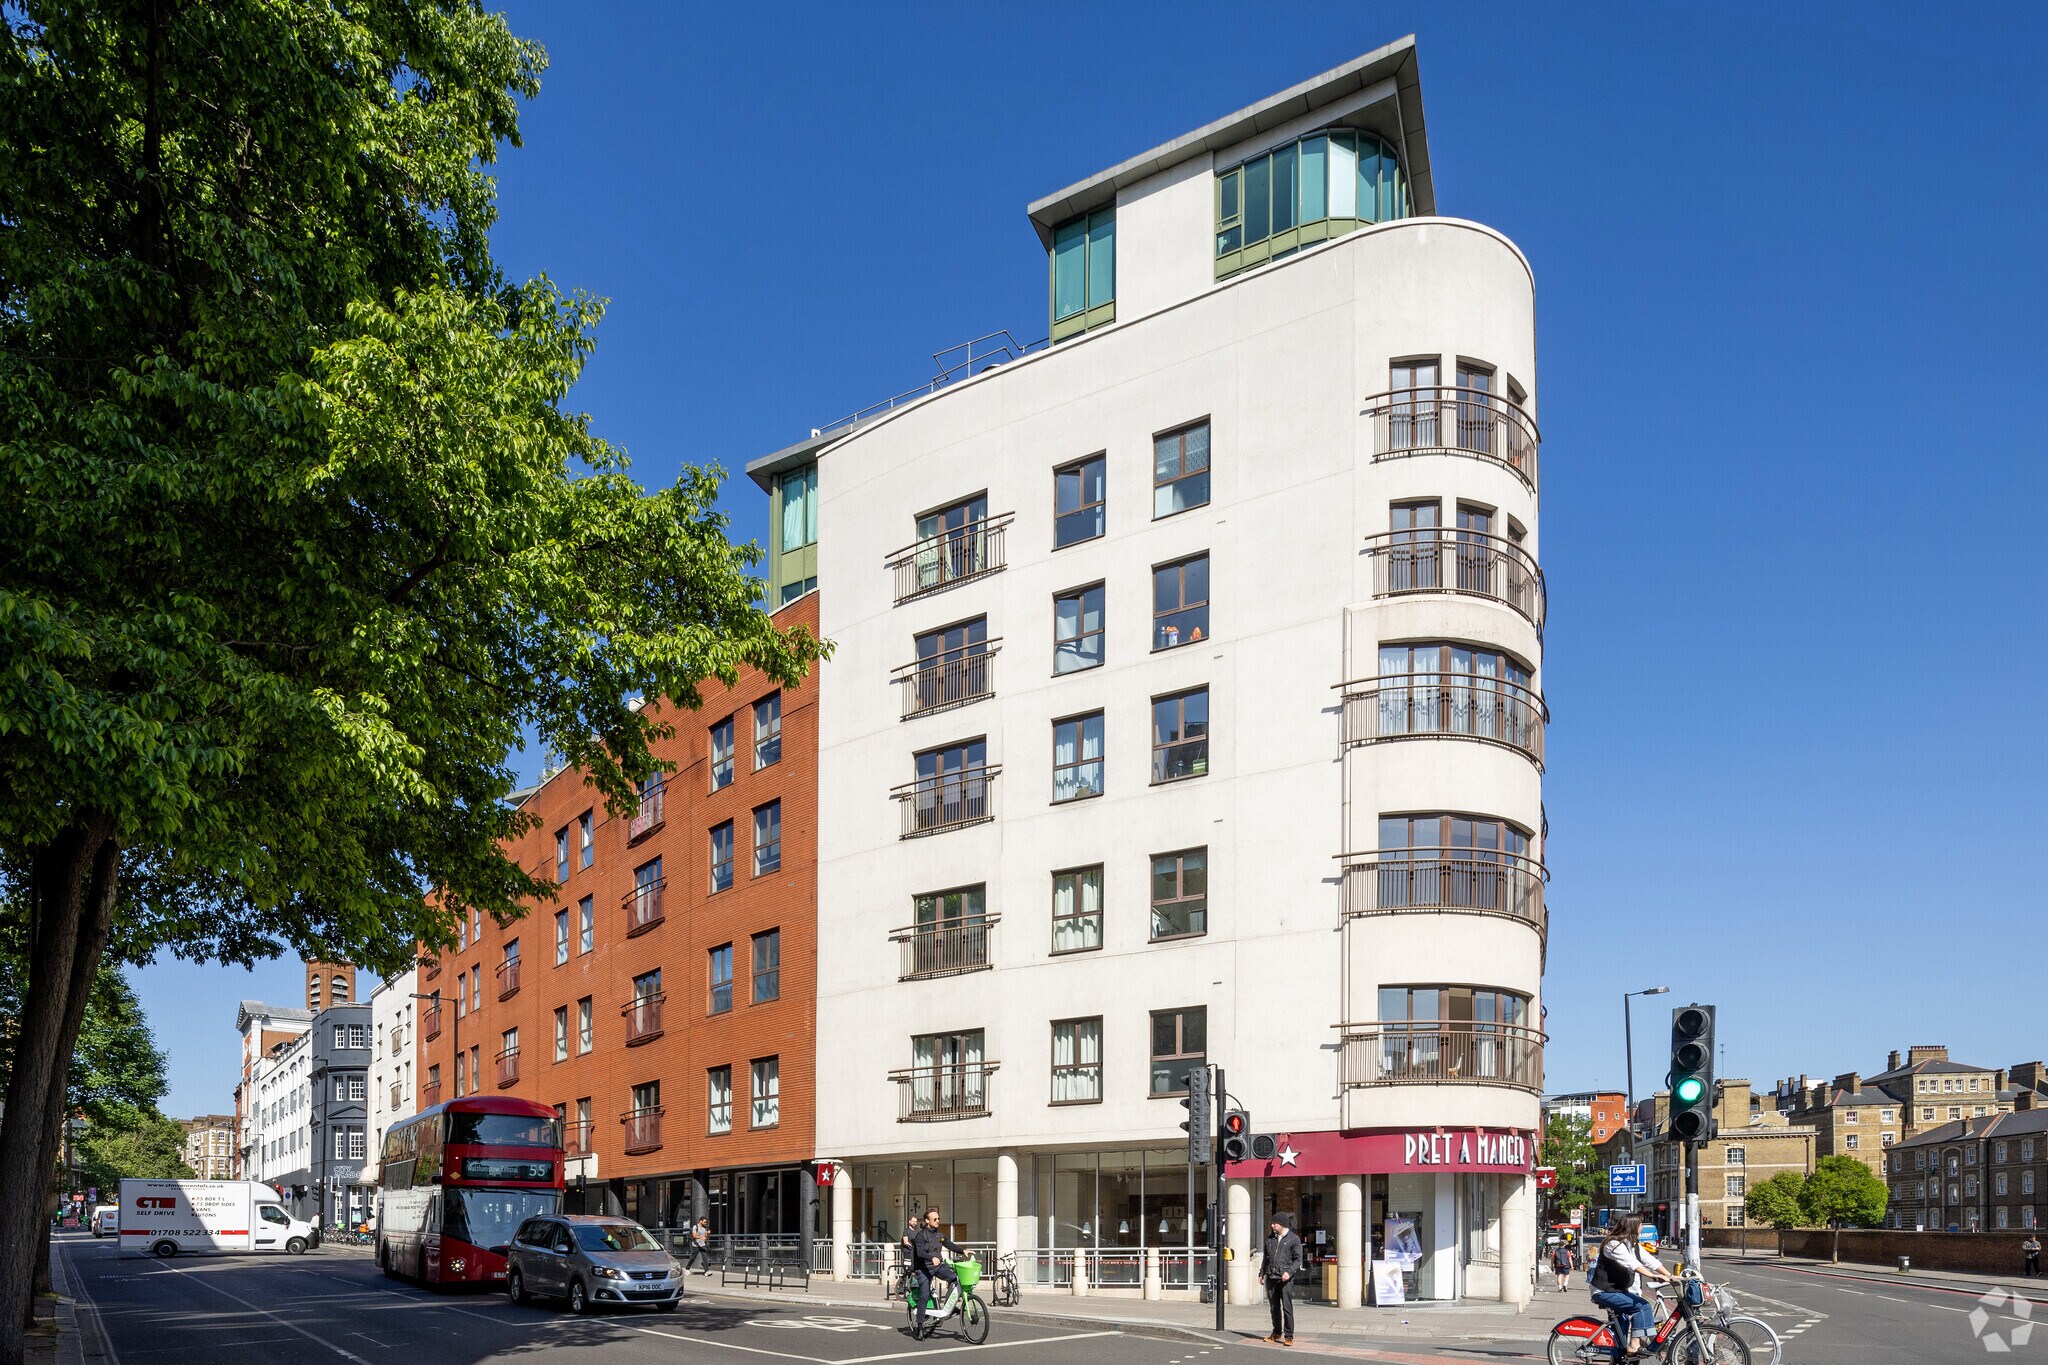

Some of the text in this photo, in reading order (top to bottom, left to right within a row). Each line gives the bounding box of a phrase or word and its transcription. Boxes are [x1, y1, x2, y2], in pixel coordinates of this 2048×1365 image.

[1404, 1133, 1526, 1165] PRET A MANGER
[529, 1165, 546, 1177] 55
[136, 1197, 176, 1208] CTM
